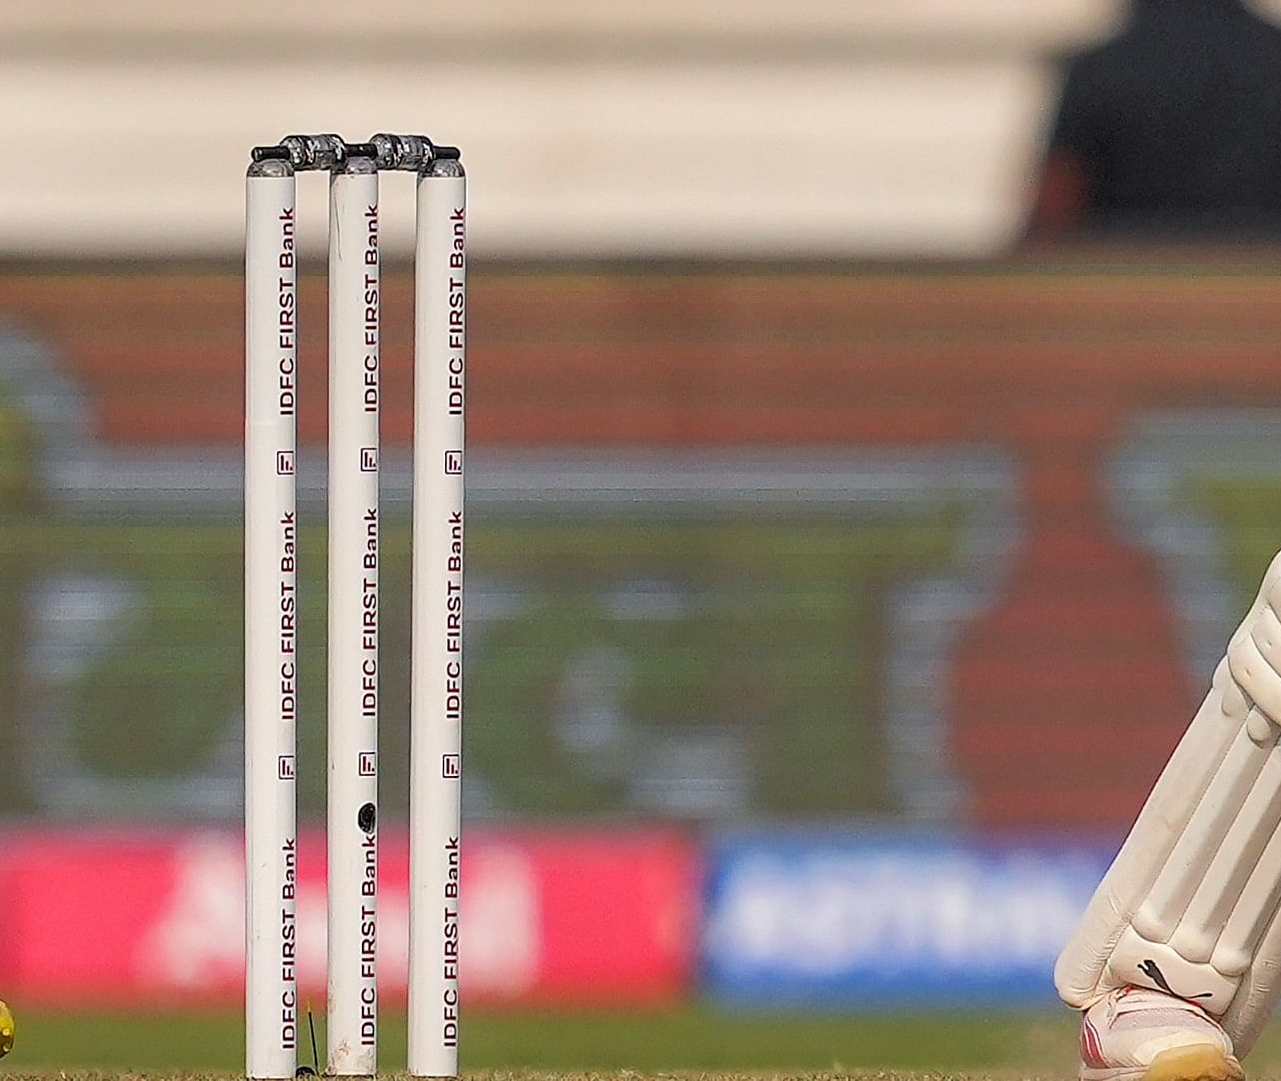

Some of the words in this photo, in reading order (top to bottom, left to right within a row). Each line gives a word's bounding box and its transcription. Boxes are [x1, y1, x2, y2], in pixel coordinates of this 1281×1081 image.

[279, 207, 294, 268] Bank
[364, 205, 378, 266] Bank
[449, 207, 465, 269] Bank
[279, 277, 294, 349] FIRST
[364, 274, 378, 346] FIRST
[448, 277, 464, 349] FIRST
[279, 357, 294, 416] IDFC
[364, 355, 377, 413] IDFC
[448, 357, 463, 415] IDFC
[280, 511, 295, 573] Bank
[363, 508, 377, 570] Bank
[448, 511, 462, 572] Bank
[280, 581, 295, 654] FIRST
[362, 577, 377, 651] FIRST
[447, 580, 461, 653] FIRST
[280, 662, 295, 720] IDFC
[362, 659, 376, 717] IDFC
[446, 661, 460, 719] IDFC
[281, 837, 296, 900] Bank
[362, 834, 376, 897] Bank
[444, 835, 459, 899] Bank
[281, 908, 296, 982] FIRST
[361, 905, 375, 978] FIRST
[444, 906, 458, 980] FIRST
[281, 990, 295, 1049] IDFC
[361, 987, 375, 1046] IDFC
[443, 988, 458, 1048] IDFC
